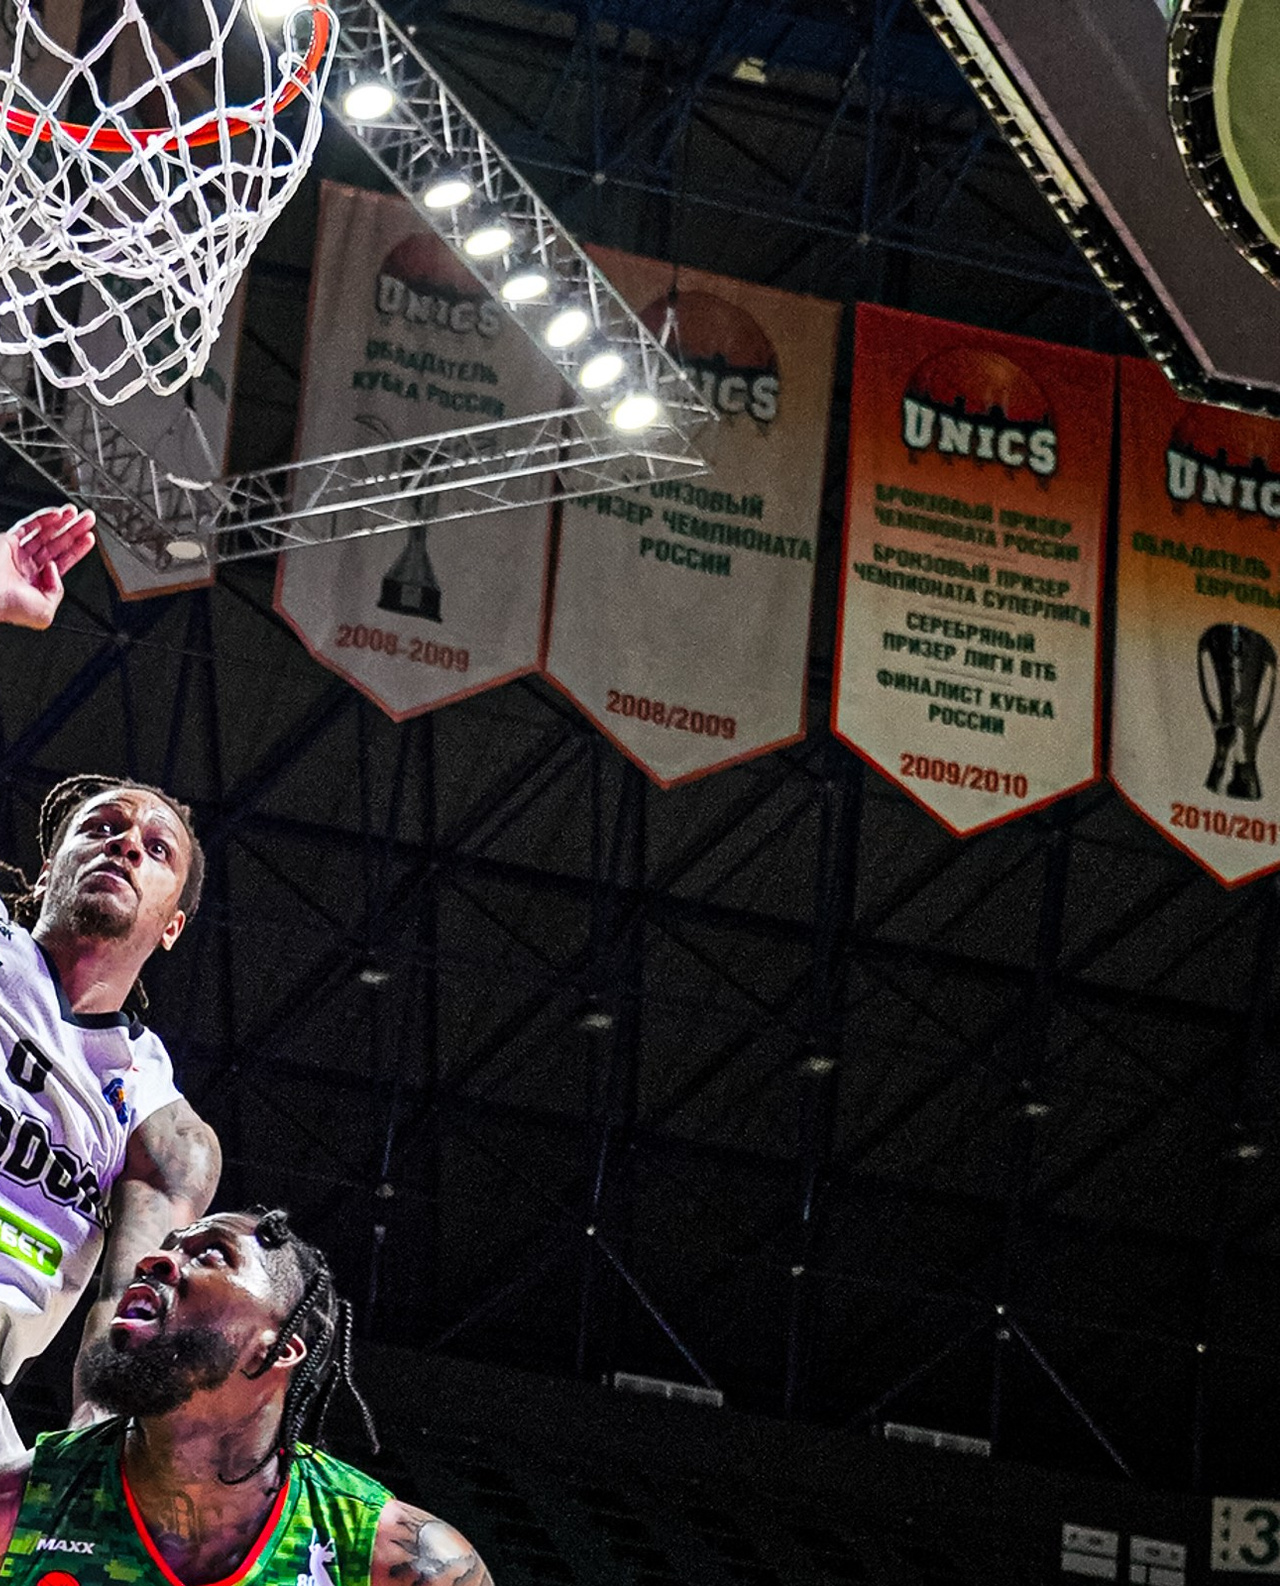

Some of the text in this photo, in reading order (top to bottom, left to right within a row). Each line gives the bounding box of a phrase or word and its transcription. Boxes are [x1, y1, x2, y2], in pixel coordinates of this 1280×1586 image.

[903, 398, 1057, 475] UNICS
[639, 535, 732, 577] РОССИИ
[662, 509, 814, 562] ЧЕМПИОНАТА
[853, 562, 1091, 628] ЧЕМПИОНАТА СУПЕРЛИГИ
[873, 543, 1071, 599] БРОНЗОВЫЙ ПРИЗЕР
[882, 631, 1058, 682] ПРИЗЕР ЛИГИ ВТБ
[906, 611, 1036, 654] СЕРЕБРЯНЫЙ
[605, 689, 737, 741] 2008/2009
[876, 667, 1055, 720] ФИНАЛИСТ КУБКА
[927, 703, 1006, 735] РОССИИ
[900, 751, 1029, 800] 2009/2010
[6, 1038, 53, 1094] 0
[36, 1538, 95, 1555] MAXX
